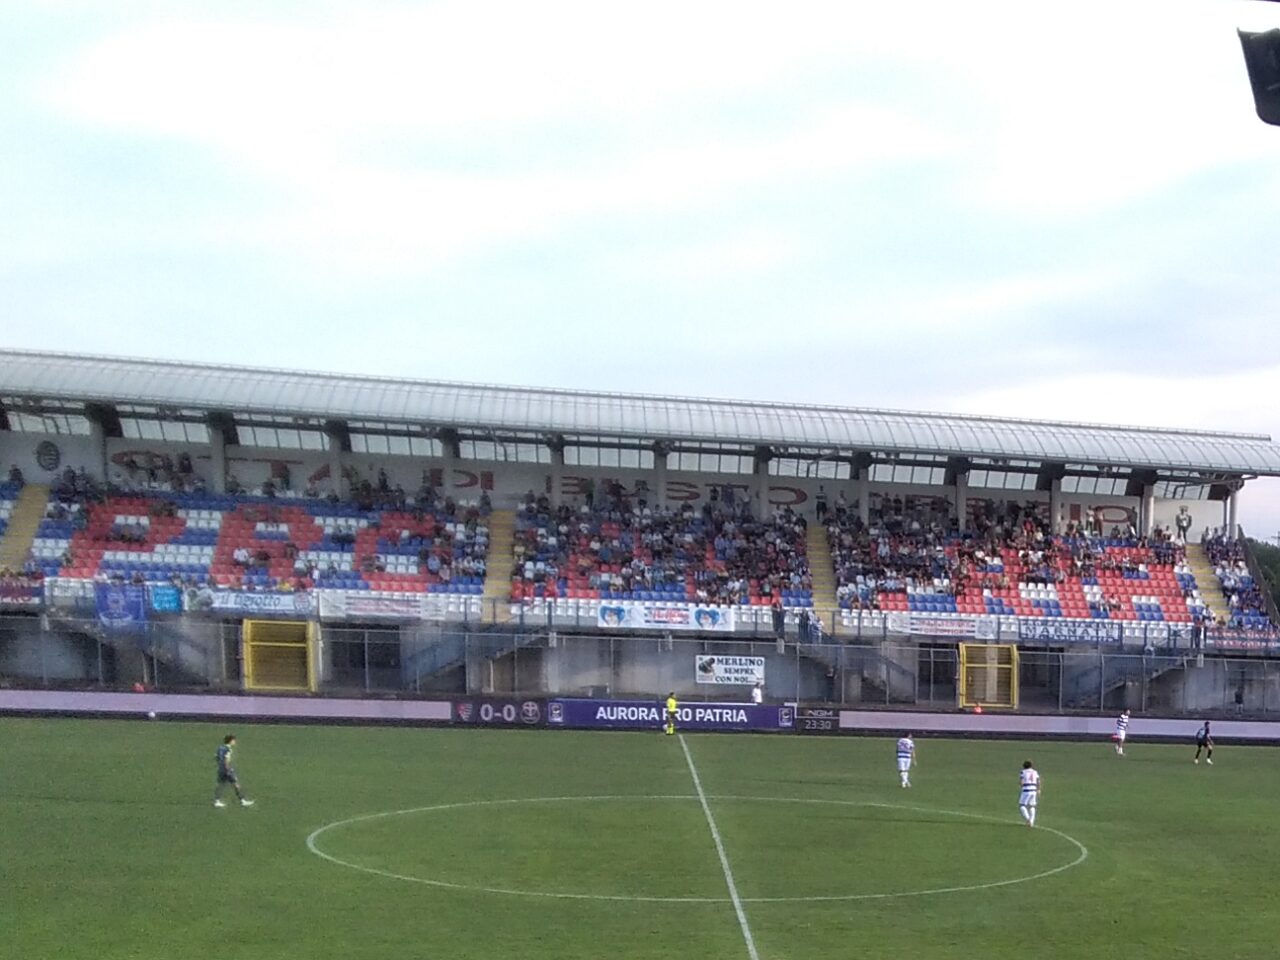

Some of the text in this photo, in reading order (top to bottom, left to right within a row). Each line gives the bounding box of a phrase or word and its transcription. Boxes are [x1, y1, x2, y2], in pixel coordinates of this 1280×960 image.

[716, 657, 763, 667] MERLINO
[481, 704, 516, 721] 0-0
[595, 706, 660, 721] AURORA
[696, 708, 748, 723] PATRIA
